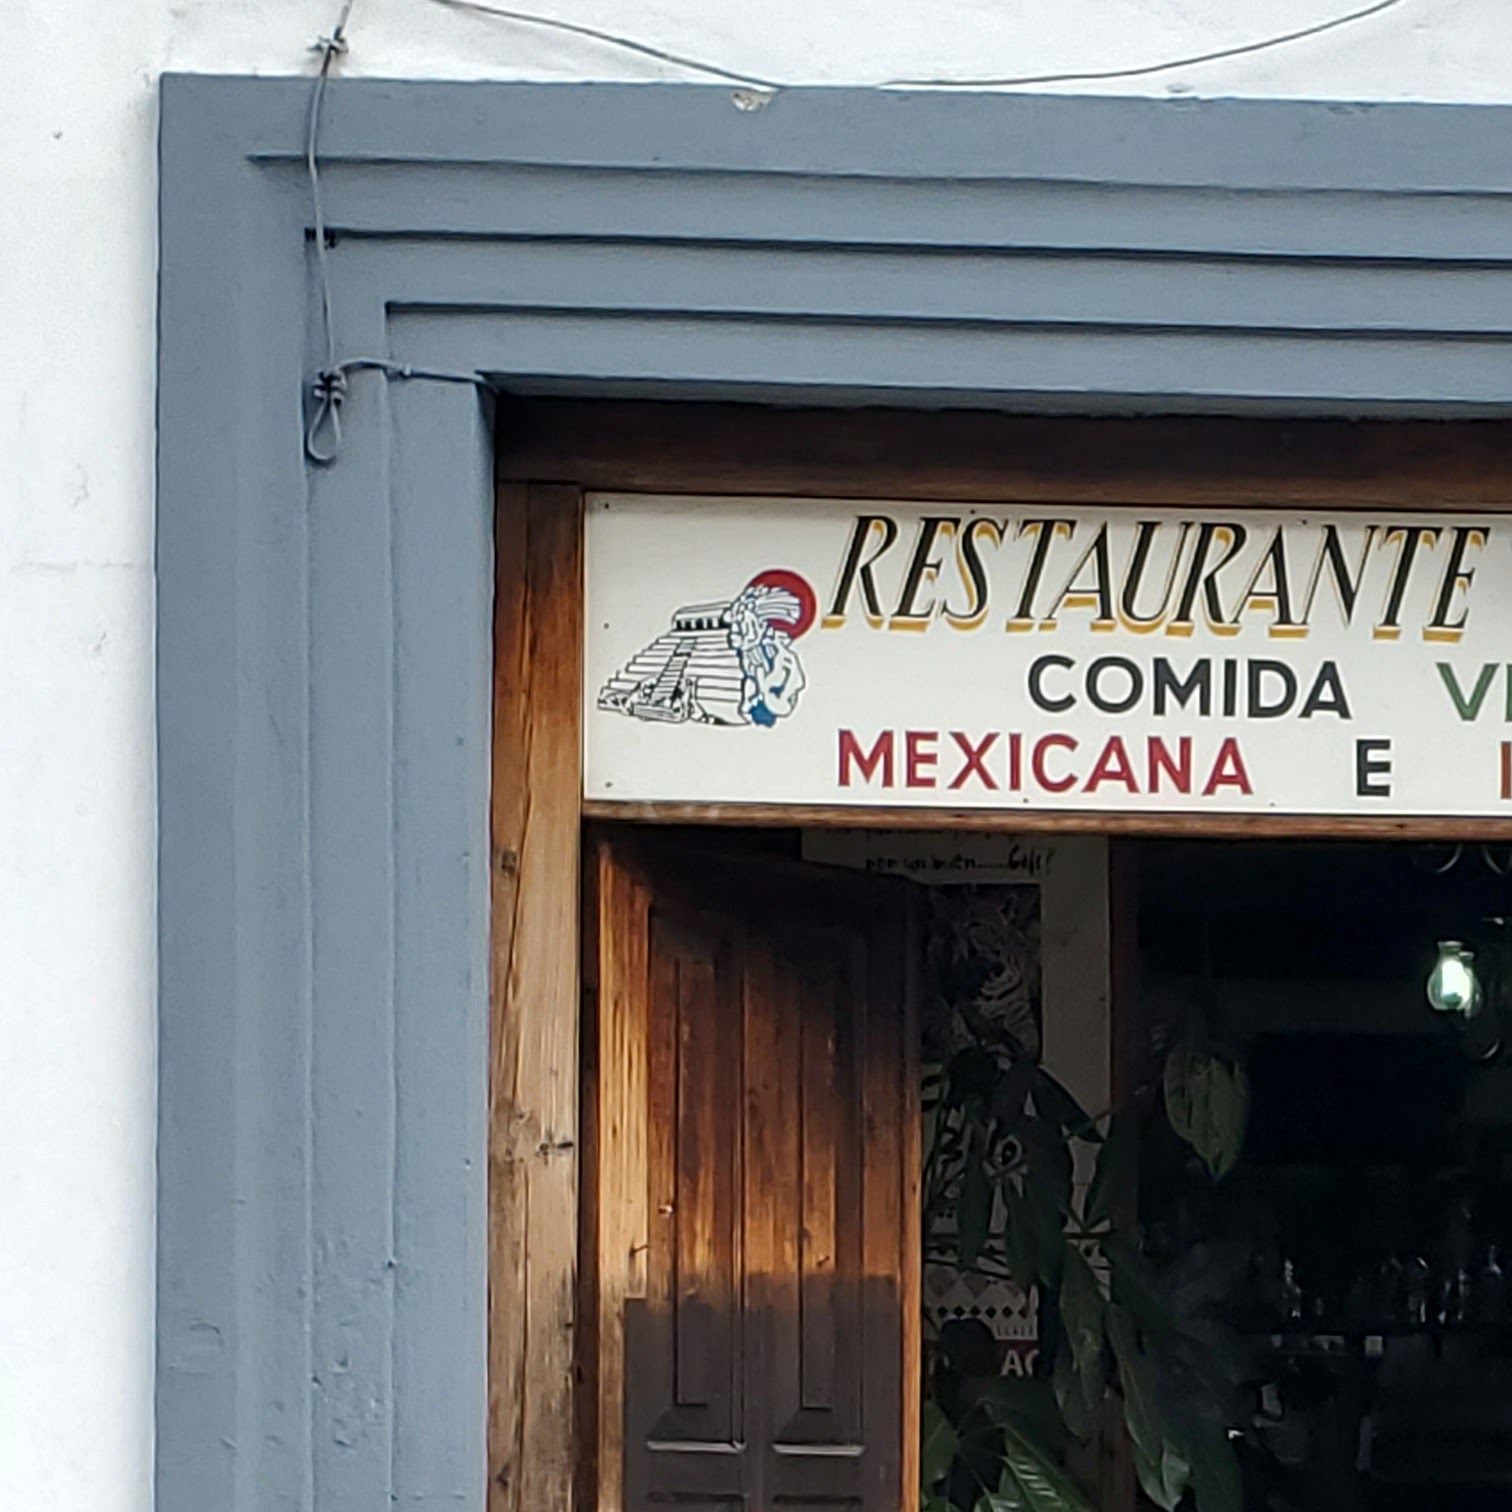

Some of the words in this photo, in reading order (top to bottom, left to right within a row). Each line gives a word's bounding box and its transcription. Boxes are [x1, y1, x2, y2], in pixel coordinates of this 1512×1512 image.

[820, 514, 1490, 642] RESTAURANTE
[1027, 654, 1353, 720] COMIDA
[837, 728, 1254, 797] MEXICANA
[1356, 738, 1392, 798] E
